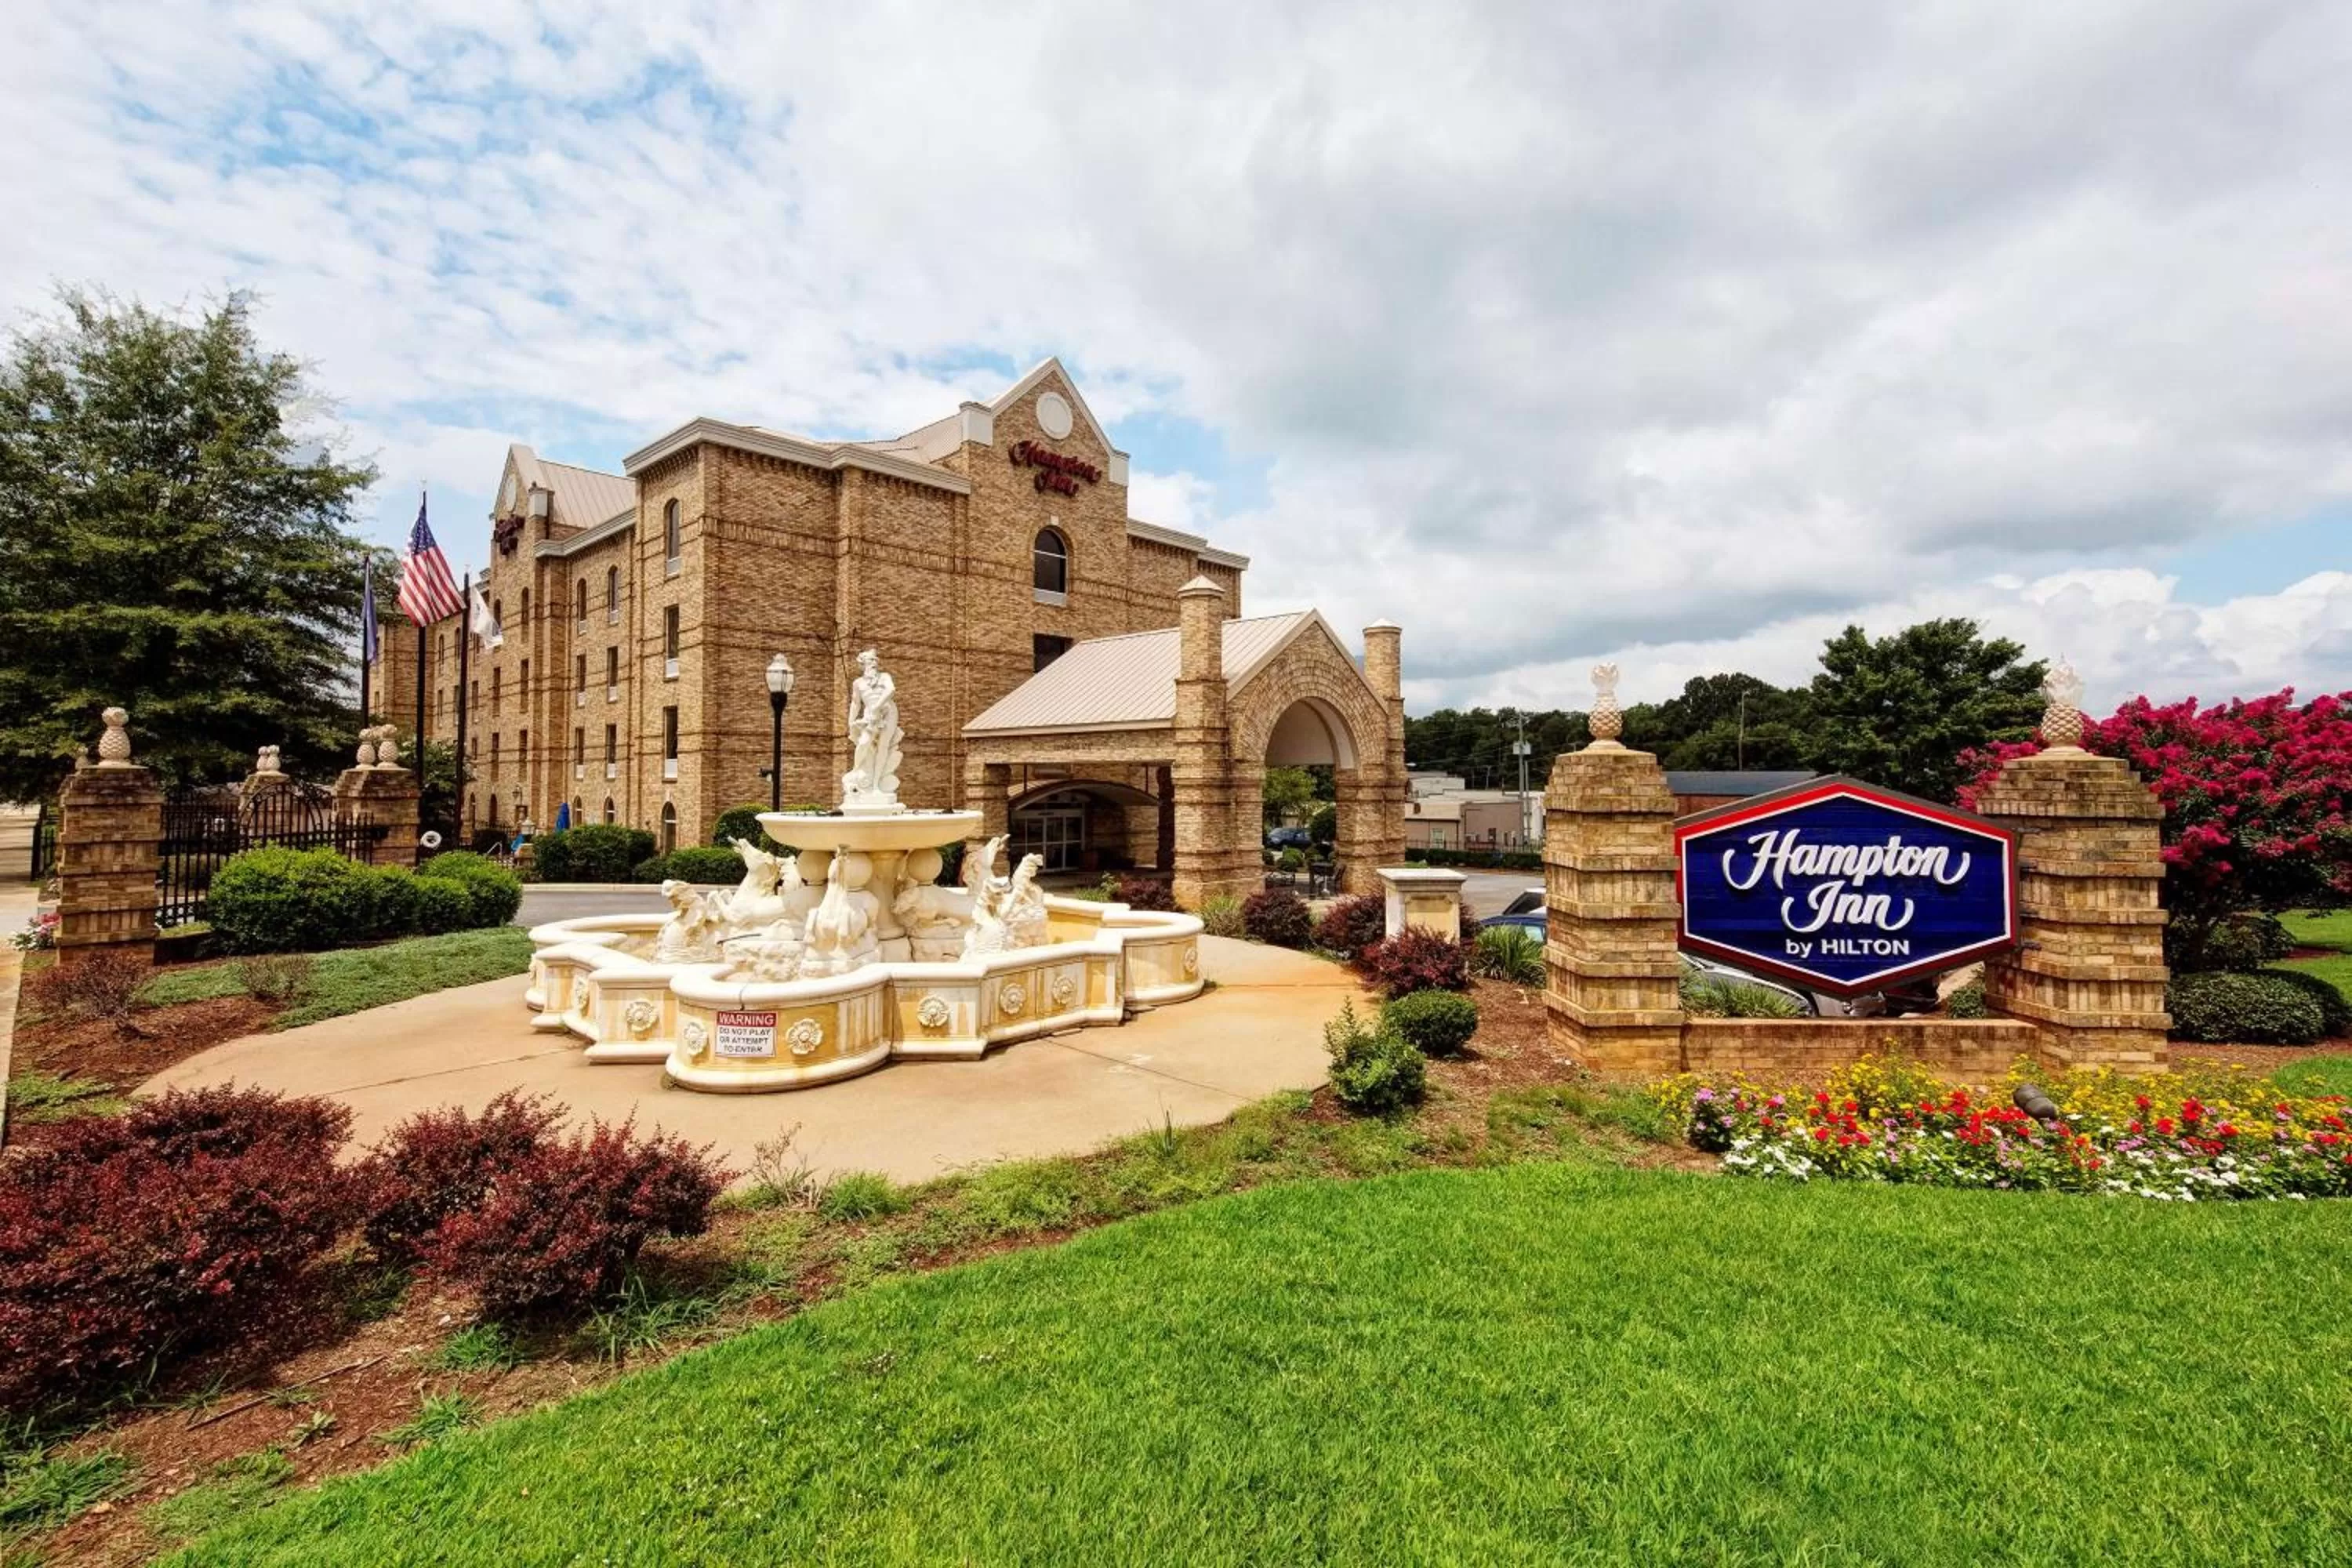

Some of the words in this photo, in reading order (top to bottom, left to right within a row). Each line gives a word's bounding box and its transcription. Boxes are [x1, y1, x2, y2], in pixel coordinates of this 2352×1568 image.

[1722, 829, 1970, 890] Hampton
[1781, 880, 1915, 932] Inn
[1786, 939, 1813, 958] by
[1821, 939, 1910, 955] HILTON
[719, 1013, 774, 1026] WARNING
